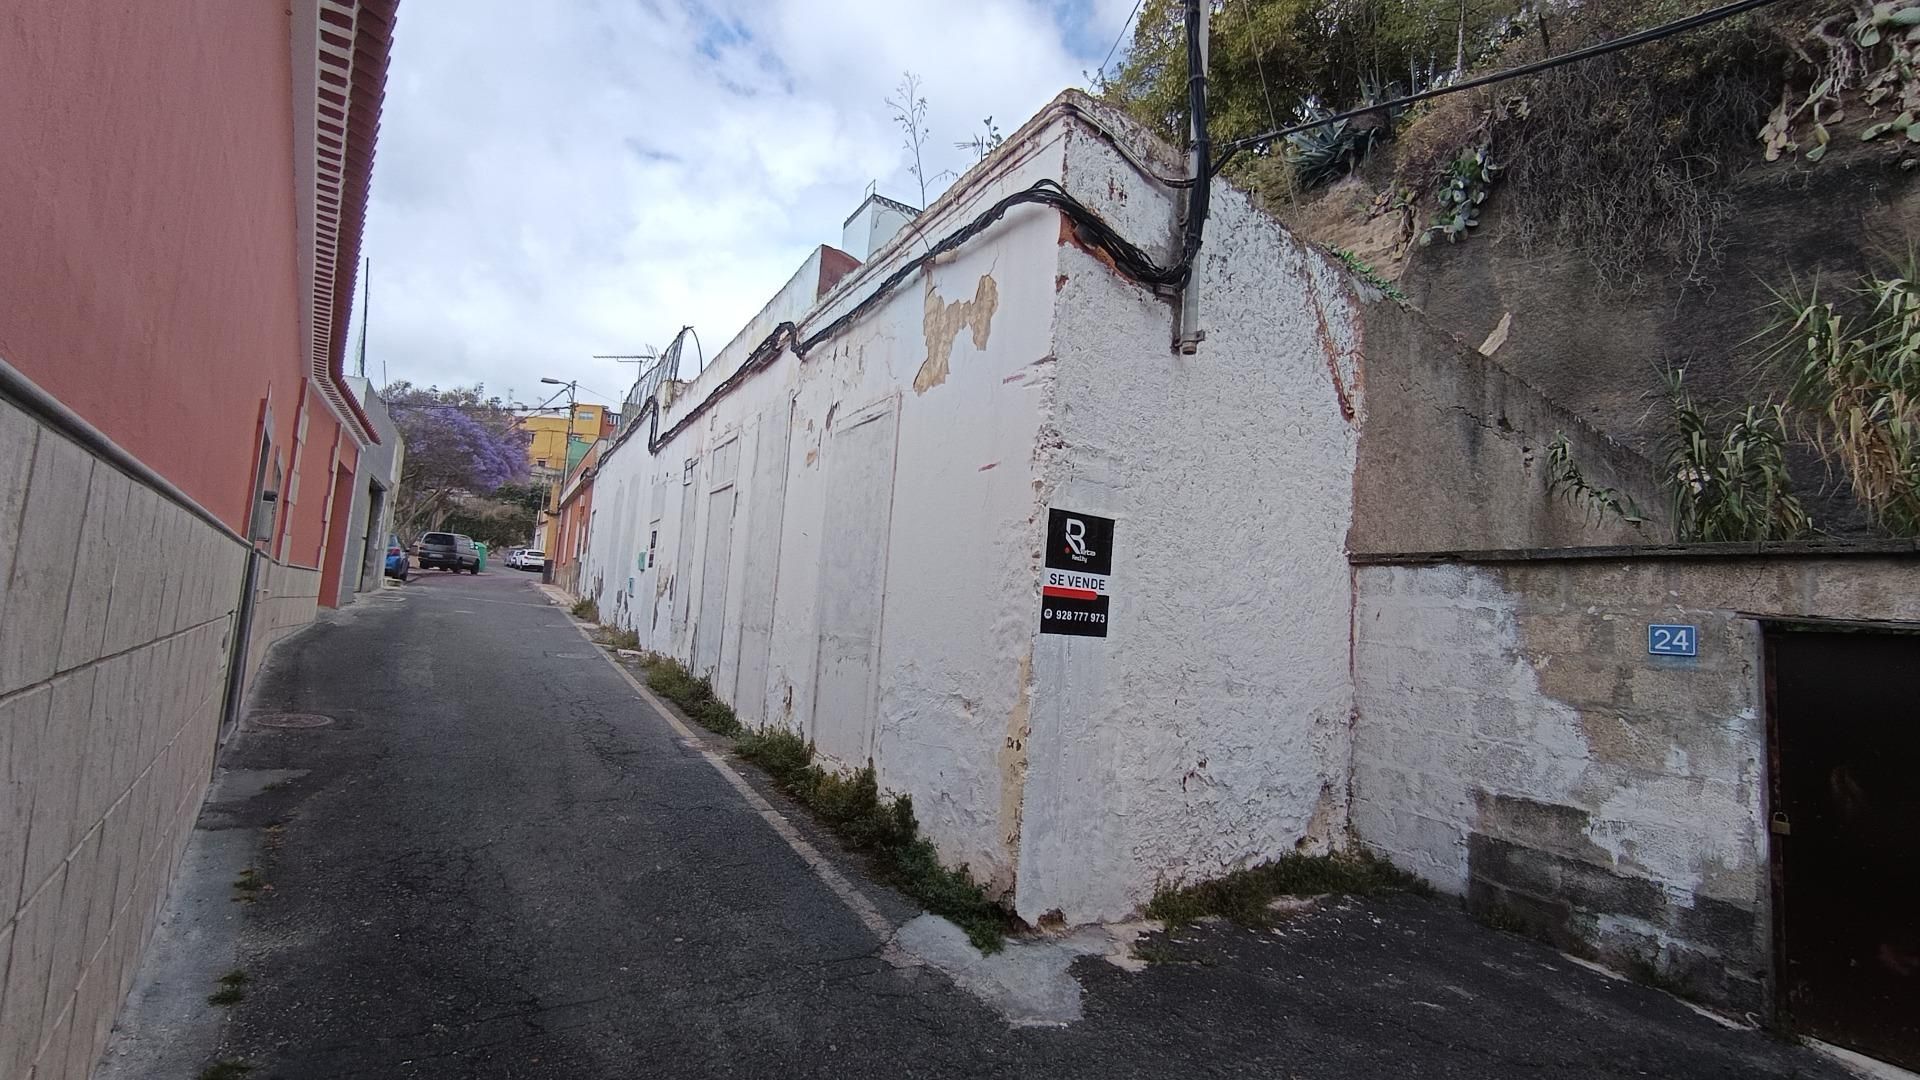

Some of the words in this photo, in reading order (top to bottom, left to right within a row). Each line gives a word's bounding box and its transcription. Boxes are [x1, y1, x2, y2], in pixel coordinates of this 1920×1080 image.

[1050, 573, 1064, 586] SE
[1067, 575, 1105, 591] VENDE
[1056, 610, 1072, 621] 928
[1073, 611, 1089, 622] 777
[1090, 613, 1106, 623] 973
[1654, 629, 1689, 651] 24
